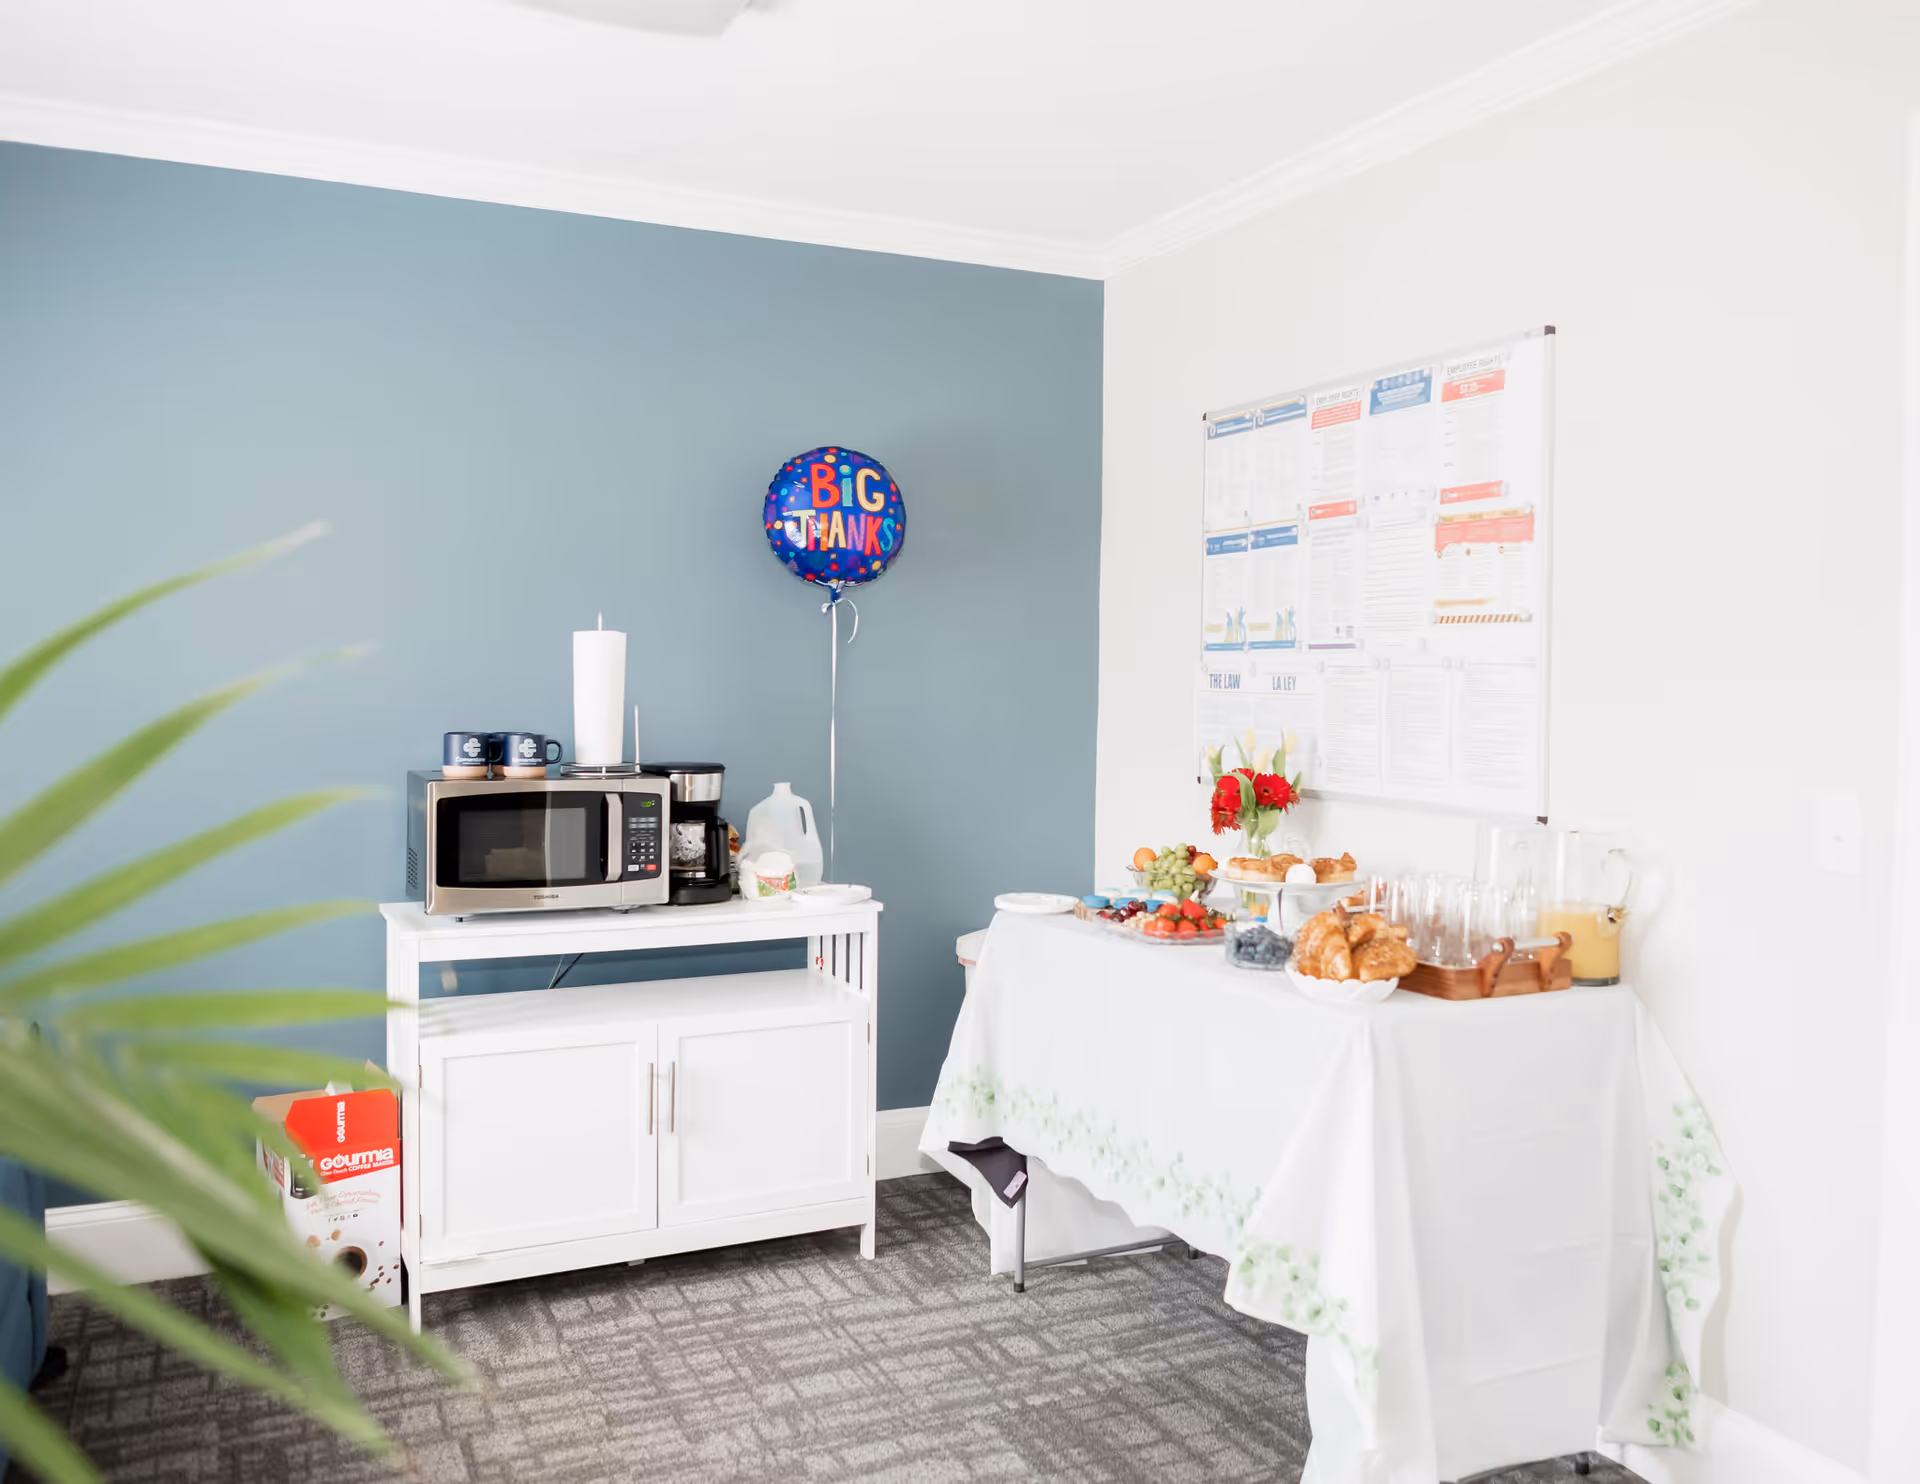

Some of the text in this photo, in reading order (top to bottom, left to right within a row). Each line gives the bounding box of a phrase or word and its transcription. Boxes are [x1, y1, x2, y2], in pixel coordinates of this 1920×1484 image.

[782, 509, 895, 557] THANKS
[1209, 673, 1241, 690] THE LAW
[1272, 676, 1297, 691] LA LEY
[348, 1163, 371, 1172] COFFEE
